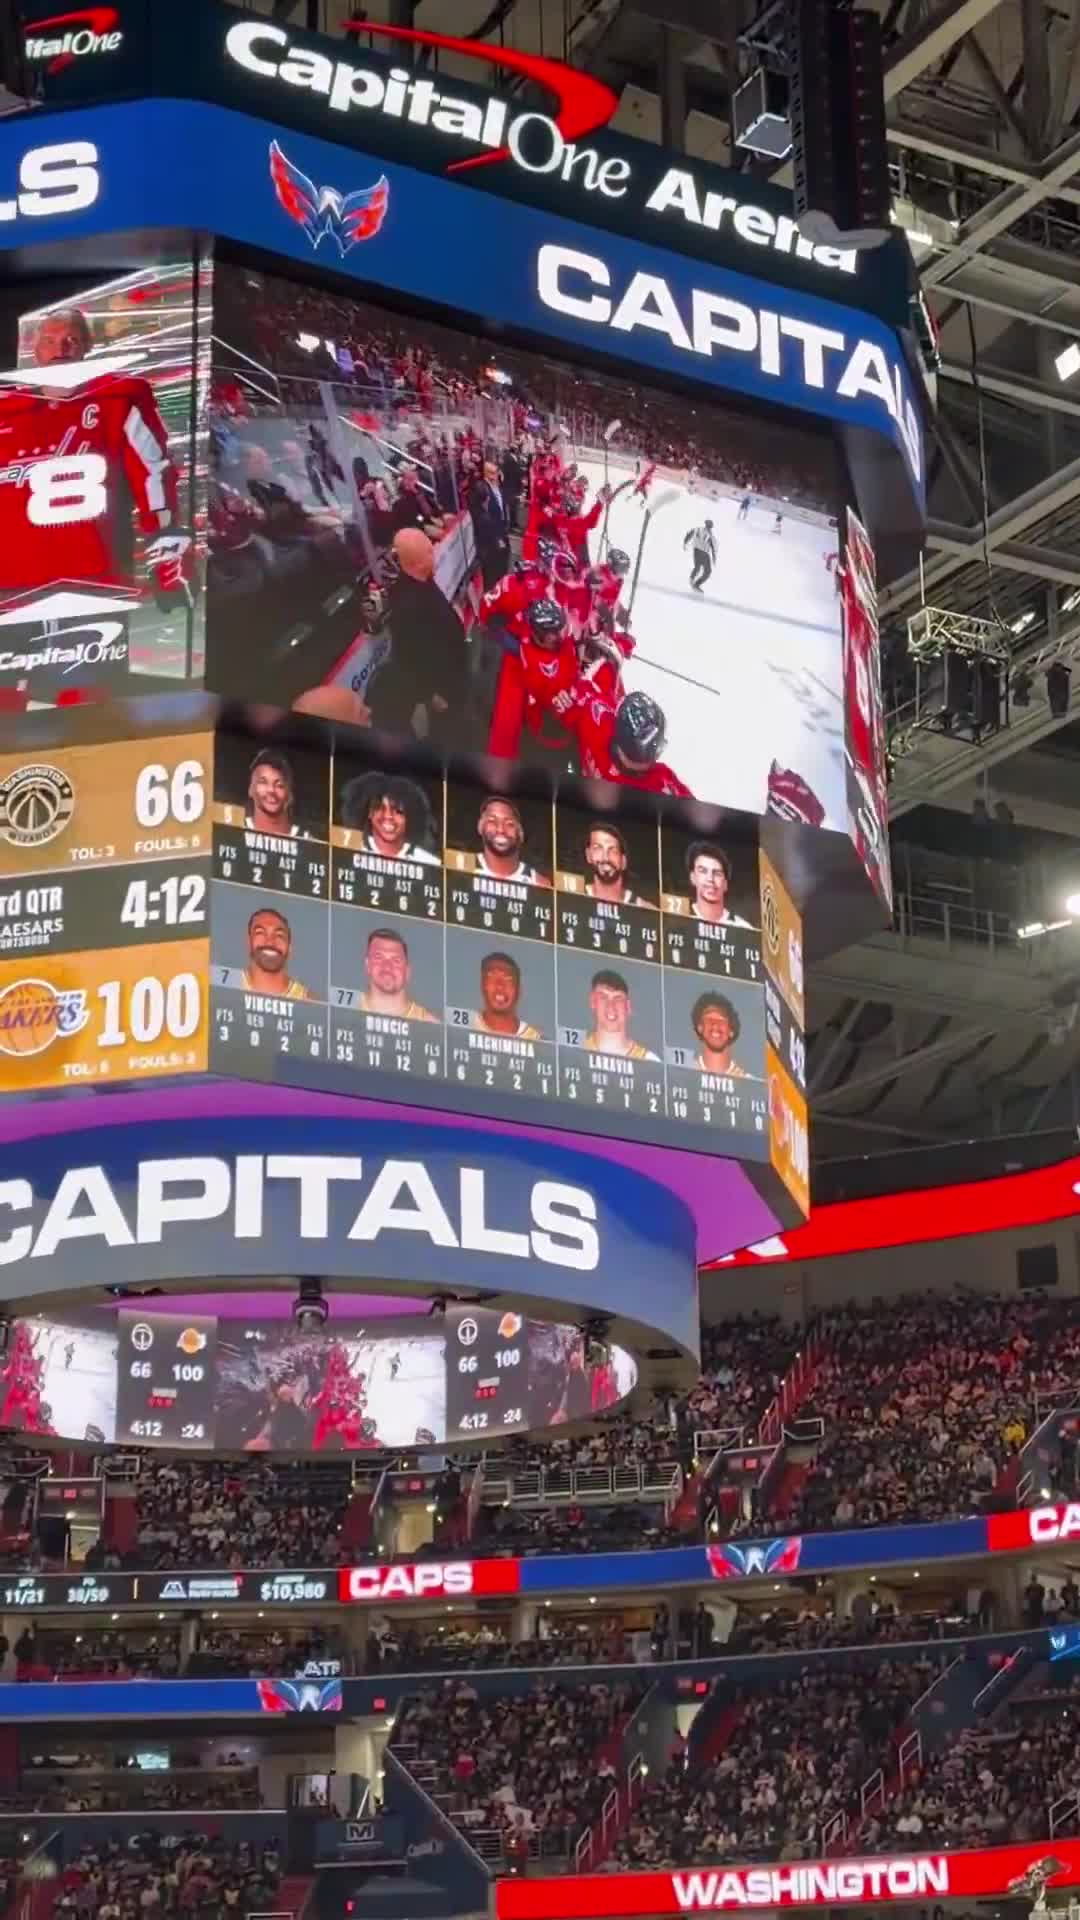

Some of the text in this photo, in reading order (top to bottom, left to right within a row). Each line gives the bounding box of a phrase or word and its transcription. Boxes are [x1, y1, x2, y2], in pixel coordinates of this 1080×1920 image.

[0, 141, 99, 221] S
[645, 167, 858, 275] Arena
[82, 403, 100, 429] C
[26, 452, 107, 526] 8
[135, 760, 205, 827] 66
[253, 867, 262, 882] 2
[284, 873, 290, 888] 1
[312, 879, 320, 894] 2
[26, 886, 62, 914] QTR
[120, 874, 205, 928] 4:12
[339, 884, 353, 900] 15
[370, 890, 379, 905] 2
[428, 901, 436, 916] 2
[512, 917, 520, 932] 0
[540, 922, 545, 937] 1
[566, 928, 654, 958] 3 3 0 0
[222, 970, 230, 984] 7
[724, 959, 730, 974] 1
[750, 964, 756, 978] 1
[97, 973, 200, 1046] 100
[244, 993, 294, 1016] VINCENT
[338, 990, 354, 1004] 77
[454, 1010, 468, 1024] 28
[220, 1026, 228, 1040] 3
[250, 1031, 259, 1046] 0
[280, 1036, 288, 1052] 2
[566, 1030, 578, 1044] 12
[337, 1044, 353, 1061] 35
[368, 1051, 380, 1066] 11
[397, 1055, 410, 1071] 12
[675, 1050, 684, 1064] 11
[485, 1070, 494, 1086] 2
[513, 1074, 521, 1090] 2
[542, 1079, 548, 1094] 1
[569, 1084, 658, 1112] 3 5 1 2
[704, 1107, 711, 1122] 3
[730, 1112, 736, 1126] 1
[130, 1361, 204, 1381] 66 100
[458, 1349, 520, 1373] 66 100
[130, 1420, 162, 1437] 4:12
[459, 1413, 488, 1430] 4:12
[349, 1564, 473, 1598] CAPS
[5, 1588, 45, 1604] 11/21
[671, 1857, 949, 1907] WASHINGTON
